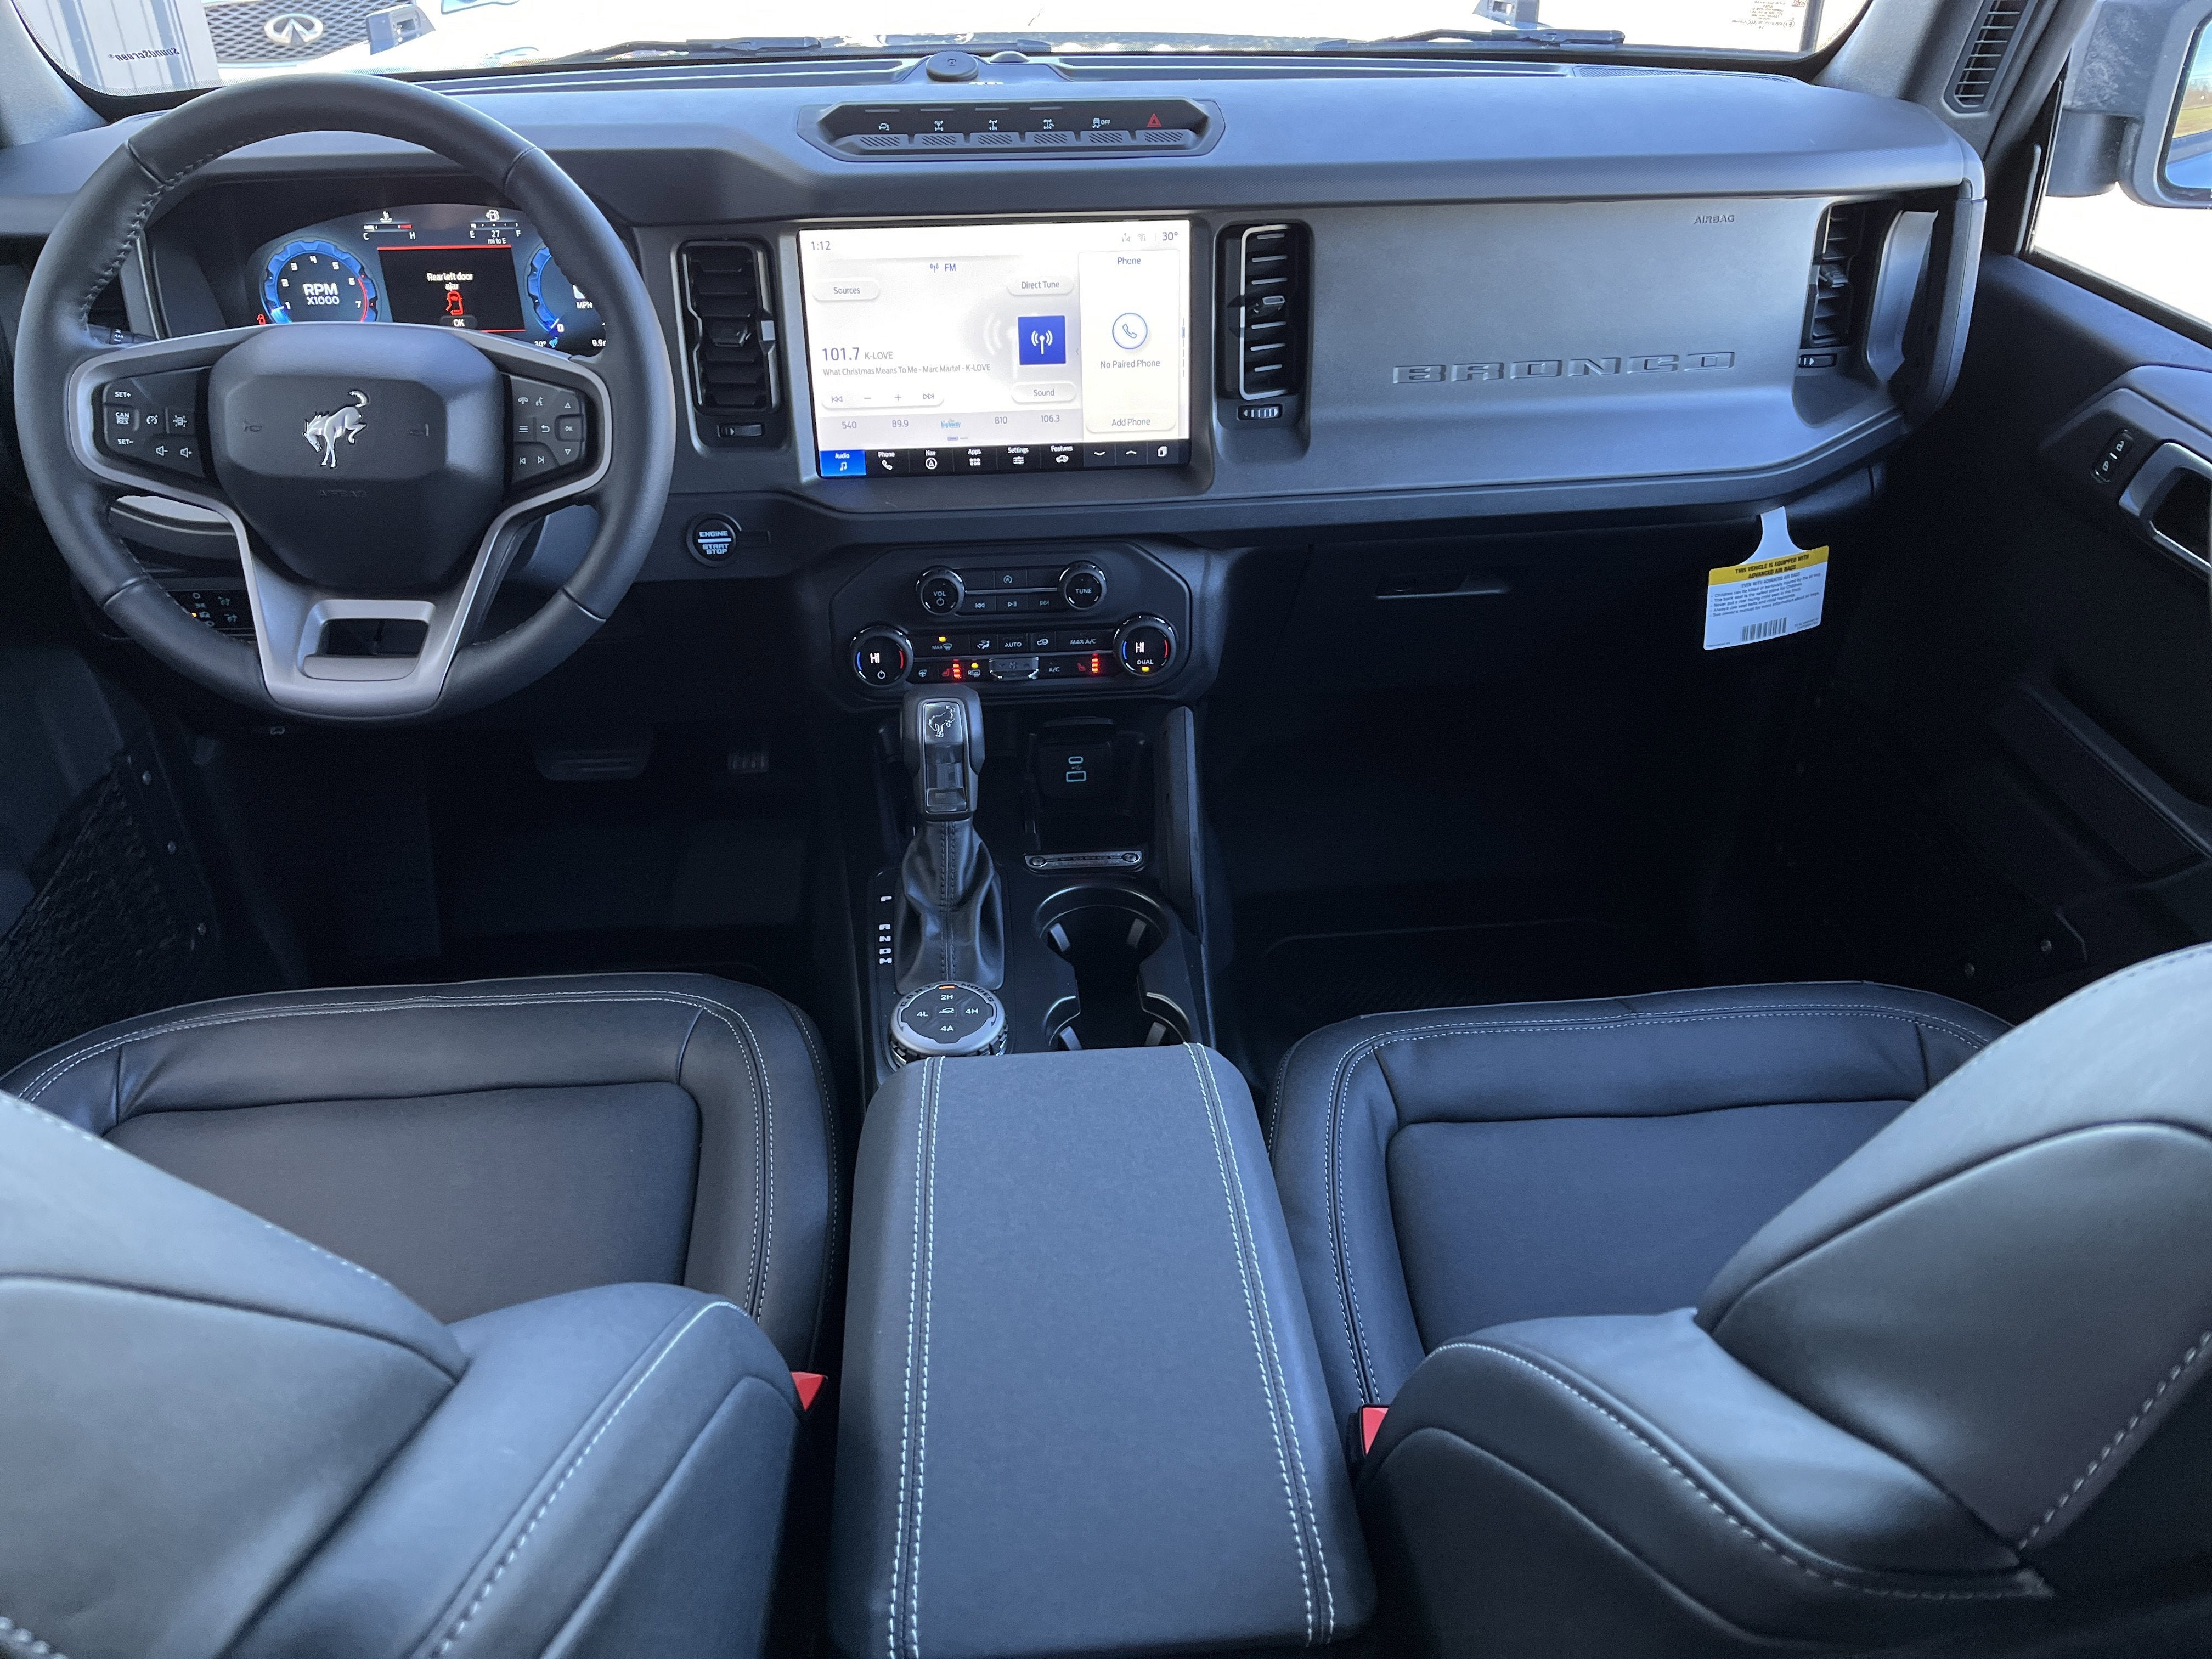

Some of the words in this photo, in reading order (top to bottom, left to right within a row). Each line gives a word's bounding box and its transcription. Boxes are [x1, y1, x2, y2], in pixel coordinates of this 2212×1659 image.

[1694, 214, 1735, 225] AIRBAG
[1163, 232, 1178, 241] 30°
[811, 241, 831, 251] 1:12
[310, 256, 317, 264] 4
[1117, 256, 1141, 266] Phone
[291, 262, 298, 271] 3
[332, 262, 339, 270] 5
[944, 263, 956, 272] FM
[427, 273, 443, 281] Rear
[443, 272, 456, 280] left
[457, 272, 473, 280] door
[281, 279, 289, 287] 2
[445, 282, 459, 291] ajar
[1021, 280, 1040, 289] Direct
[1042, 280, 1059, 289] Tune
[303, 283, 338, 296] RPM
[833, 286, 860, 295] Sources
[306, 296, 340, 306] X1000
[557, 323, 565, 332] 0
[822, 347, 860, 361] 101.7
[864, 351, 893, 360] K-LOVE
[1100, 359, 1111, 368] No
[1113, 358, 1135, 368] Paired
[1136, 358, 1160, 368] Phone
[1392, 351, 1735, 384] BRONCO
[843, 368, 874, 376] Christmas
[876, 366, 897, 375] Means
[898, 366, 906, 374] To
[1033, 388, 1055, 397] Sound
[892, 419, 909, 428] 89.9
[994, 416, 1008, 425] 810
[1040, 414, 1060, 424] 106.3
[1111, 418, 1128, 427] Add
[1130, 417, 1150, 426] Phone
[842, 421, 857, 430] 540
[941, 420, 961, 428] highway
[1748, 563, 1768, 572] VEHICLE
[1774, 557, 1797, 566] EQUIPPED
[1748, 569, 1774, 578] ADVANCED
[1135, 642, 1144, 653] HI
[870, 652, 880, 663] HI
[961, 983, 995, 1003] MODES
